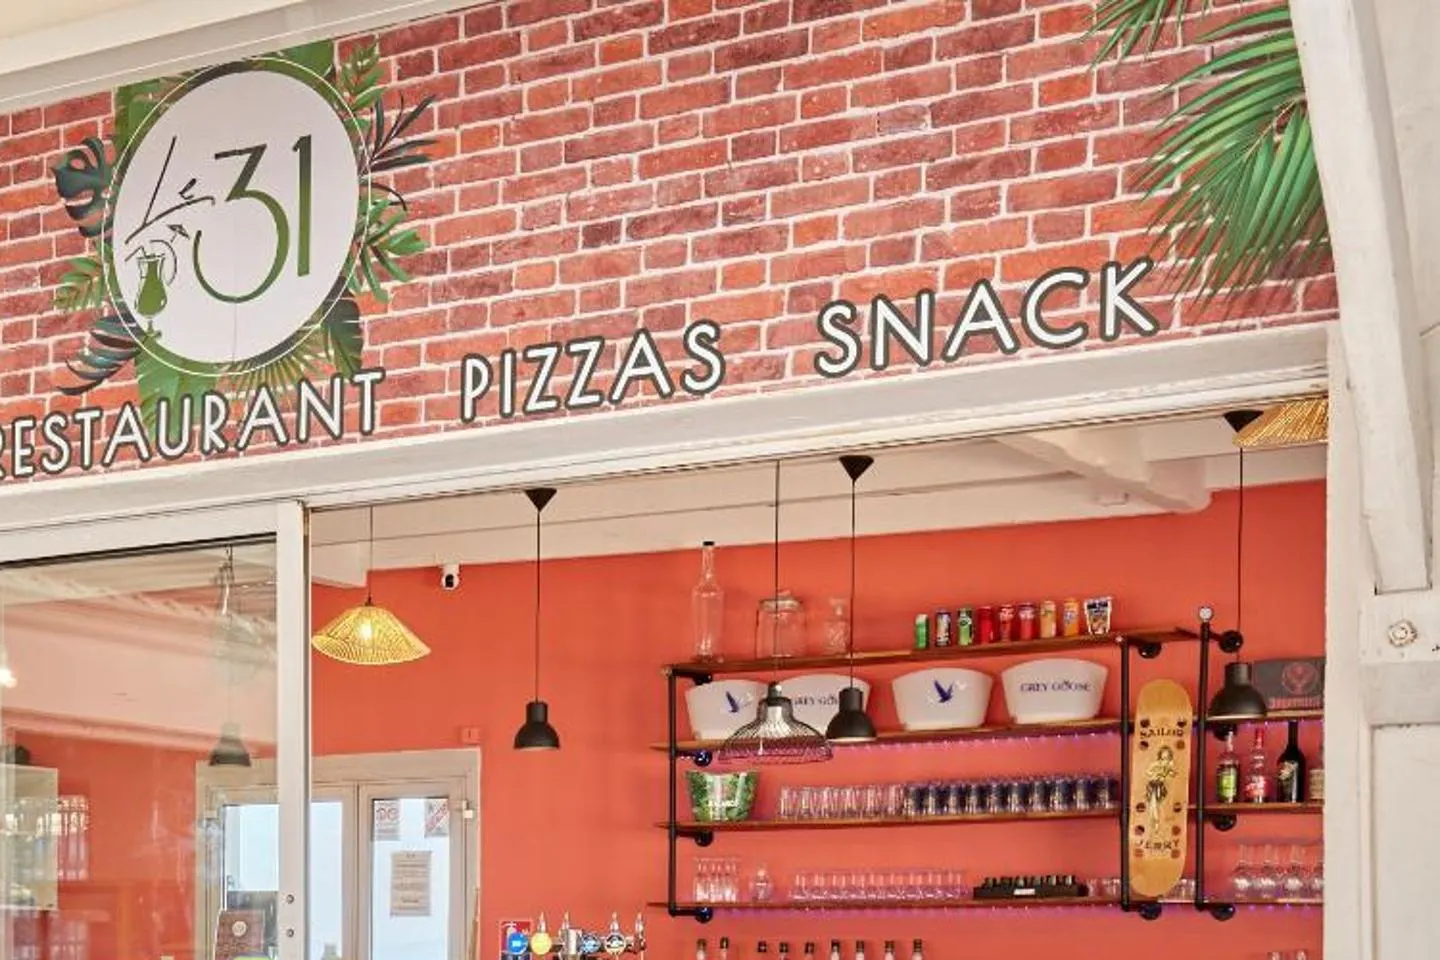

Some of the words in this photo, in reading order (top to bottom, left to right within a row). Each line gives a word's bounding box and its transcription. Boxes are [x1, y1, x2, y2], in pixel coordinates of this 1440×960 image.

[192, 134, 312, 304] 31
[461, 318, 726, 424] PIZZAS
[814, 256, 1160, 378] SNACK
[1020, 682, 1048, 692] GREY
